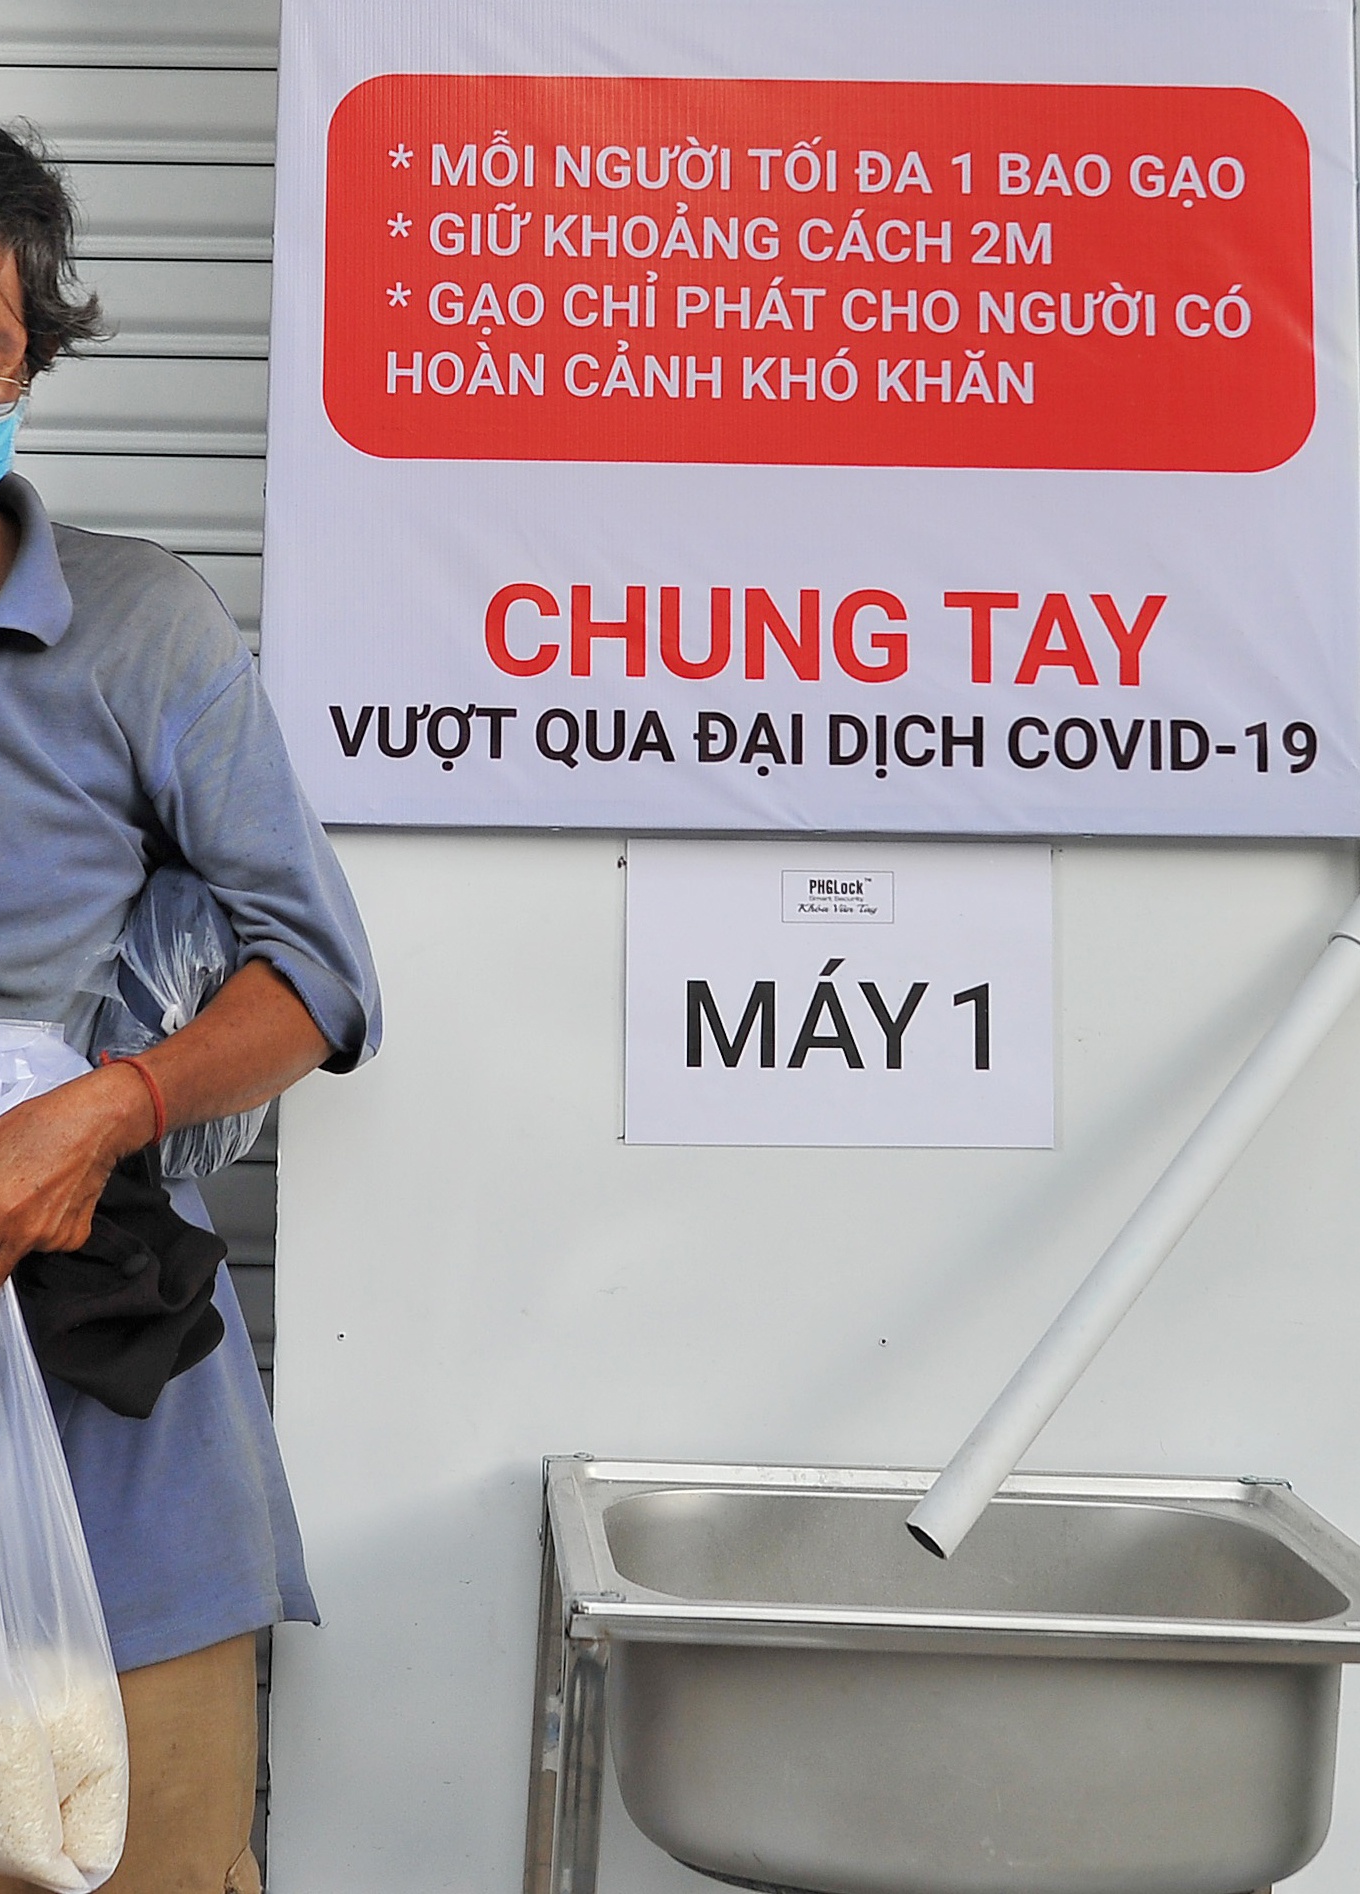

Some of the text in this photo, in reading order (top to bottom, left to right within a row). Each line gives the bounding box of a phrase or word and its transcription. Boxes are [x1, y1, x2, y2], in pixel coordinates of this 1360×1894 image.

[431, 129, 1245, 208] MỖI NGƯỜI TỐI ĐA 1 BAO GẠO
[429, 201, 1052, 265] GIỮ KHOẢNG CÁCH 2M
[428, 270, 1251, 339] GẠO CHỈ PHÁT CHO NGƯỜI CÓ
[386, 339, 1034, 404] HOÀN CẢNH KHÓ KHĂN
[484, 582, 1168, 687] CHUNG TAY
[328, 703, 1318, 779] VƯỢT QUA ĐẠI DỊCH COVID-19
[686, 958, 990, 1071] MÁY 1
